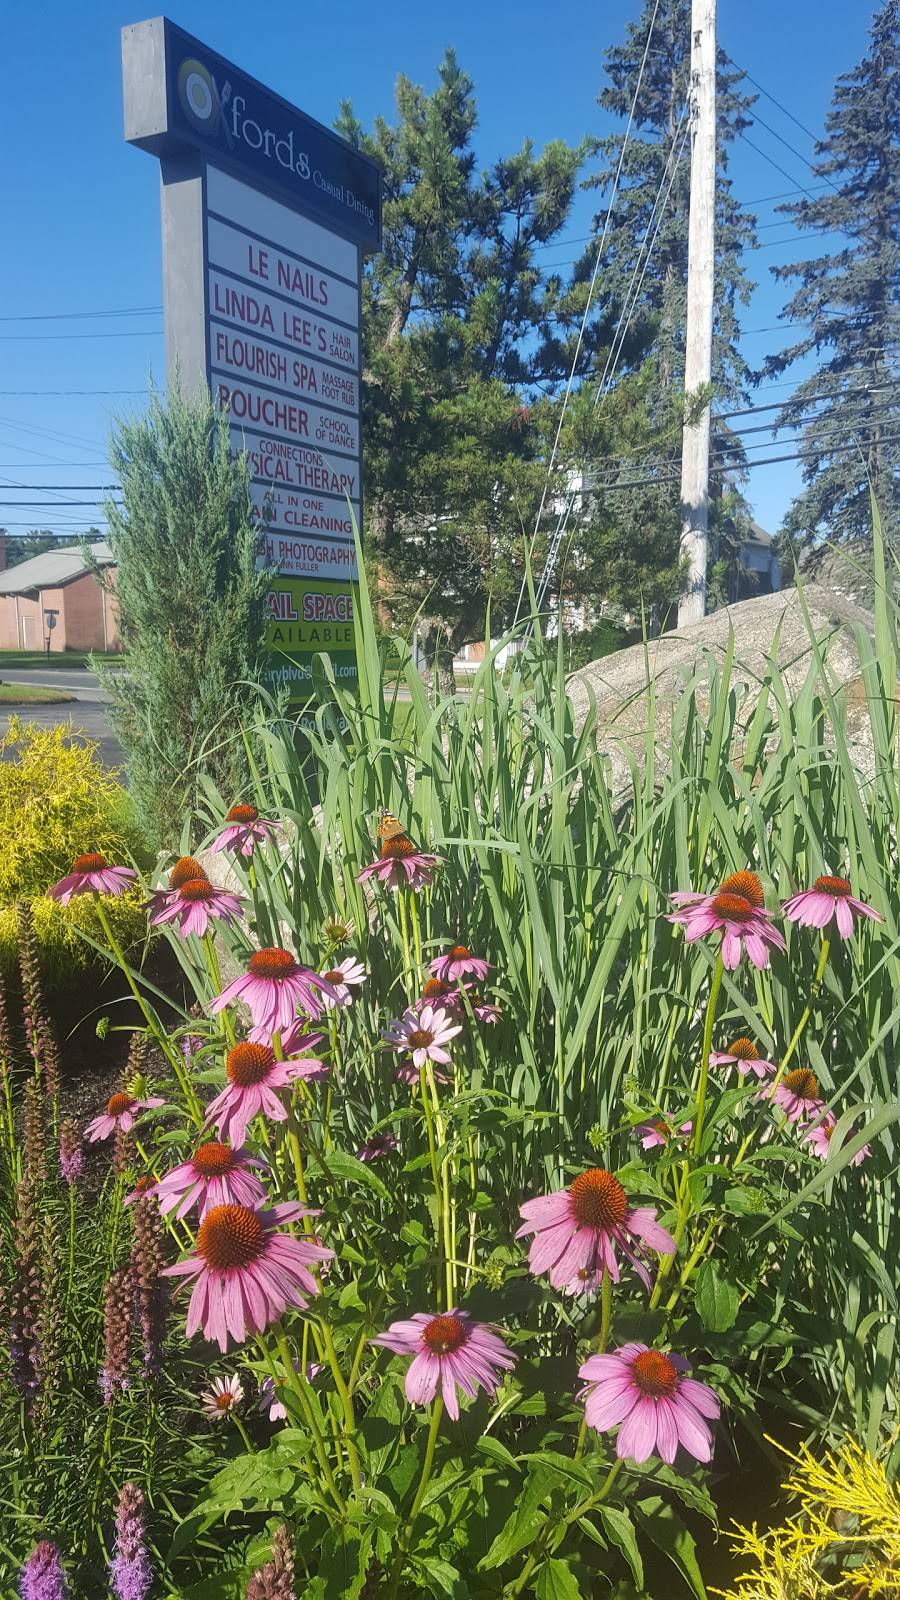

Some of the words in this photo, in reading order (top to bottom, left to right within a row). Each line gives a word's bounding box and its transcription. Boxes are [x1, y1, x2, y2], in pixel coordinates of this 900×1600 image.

[313, 170, 344, 202] Casual
[346, 190, 375, 226] Dining
[248, 245, 269, 280] LE
[277, 259, 328, 306] NAILS
[214, 283, 275, 333] LINDA
[283, 311, 327, 352] LEE'S
[332, 331, 351, 348] HAIR
[216, 331, 287, 383] FLOURISH
[292, 360, 318, 393] SPA
[329, 344, 355, 364] SALON
[322, 371, 354, 392] MASSAGE
[321, 384, 340, 400] FOOT
[341, 390, 355, 407] RUB
[319, 416, 351, 436] SCHOOL
[315, 428, 326, 440] OF
[328, 432, 355, 449] DANCE
[259, 439, 324, 467] CONNECTIONS
[295, 463, 355, 496] THERAPY
[263, 491, 284, 504] ALL
[287, 496, 298, 507] IN
[302, 499, 324, 512] ONE
[284, 510, 353, 533] CLEANING
[279, 540, 356, 565] PHOTOGRAPHY
[295, 561, 320, 572] FULLER
[303, 593, 354, 622] SPACE
[272, 627, 352, 642] AILABLE
